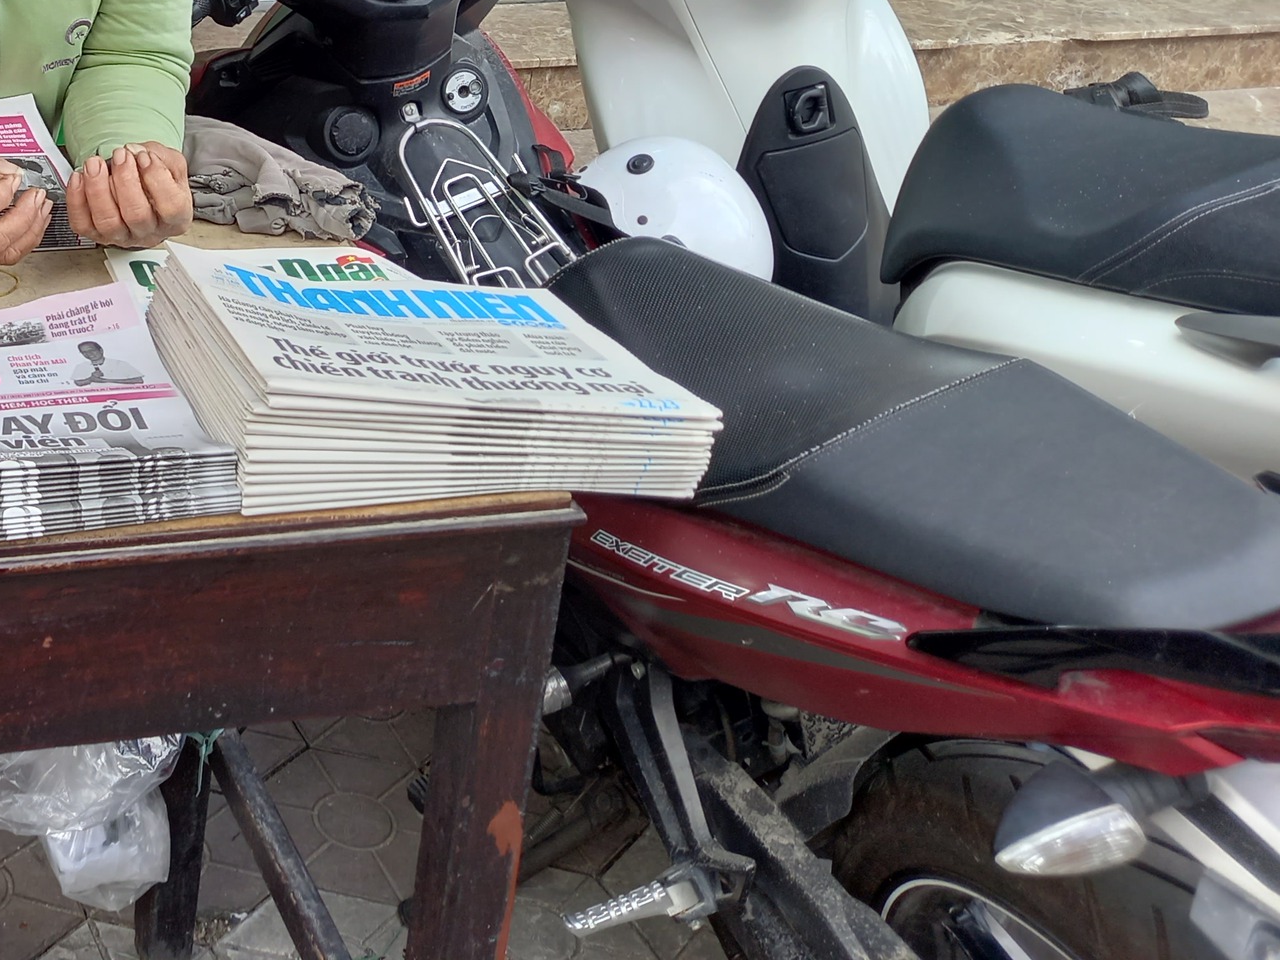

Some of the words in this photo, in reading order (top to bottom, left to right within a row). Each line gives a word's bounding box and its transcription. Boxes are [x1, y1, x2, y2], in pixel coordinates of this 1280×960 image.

[99, 298, 114, 310] hội
[223, 263, 431, 318] THANH
[410, 288, 558, 323] NIÊN
[48, 321, 71, 332] đang
[266, 335, 331, 360] Thế
[335, 349, 401, 366] giới
[399, 353, 489, 376] trước
[488, 363, 574, 380] nguy
[575, 364, 613, 379] cơ
[272, 353, 367, 378] chiến
[366, 365, 463, 390] tranh
[461, 370, 590, 396] thương
[586, 380, 655, 398] mại
[63, 400, 150, 434] ĐỔI
[0, 434, 86, 451] viên
